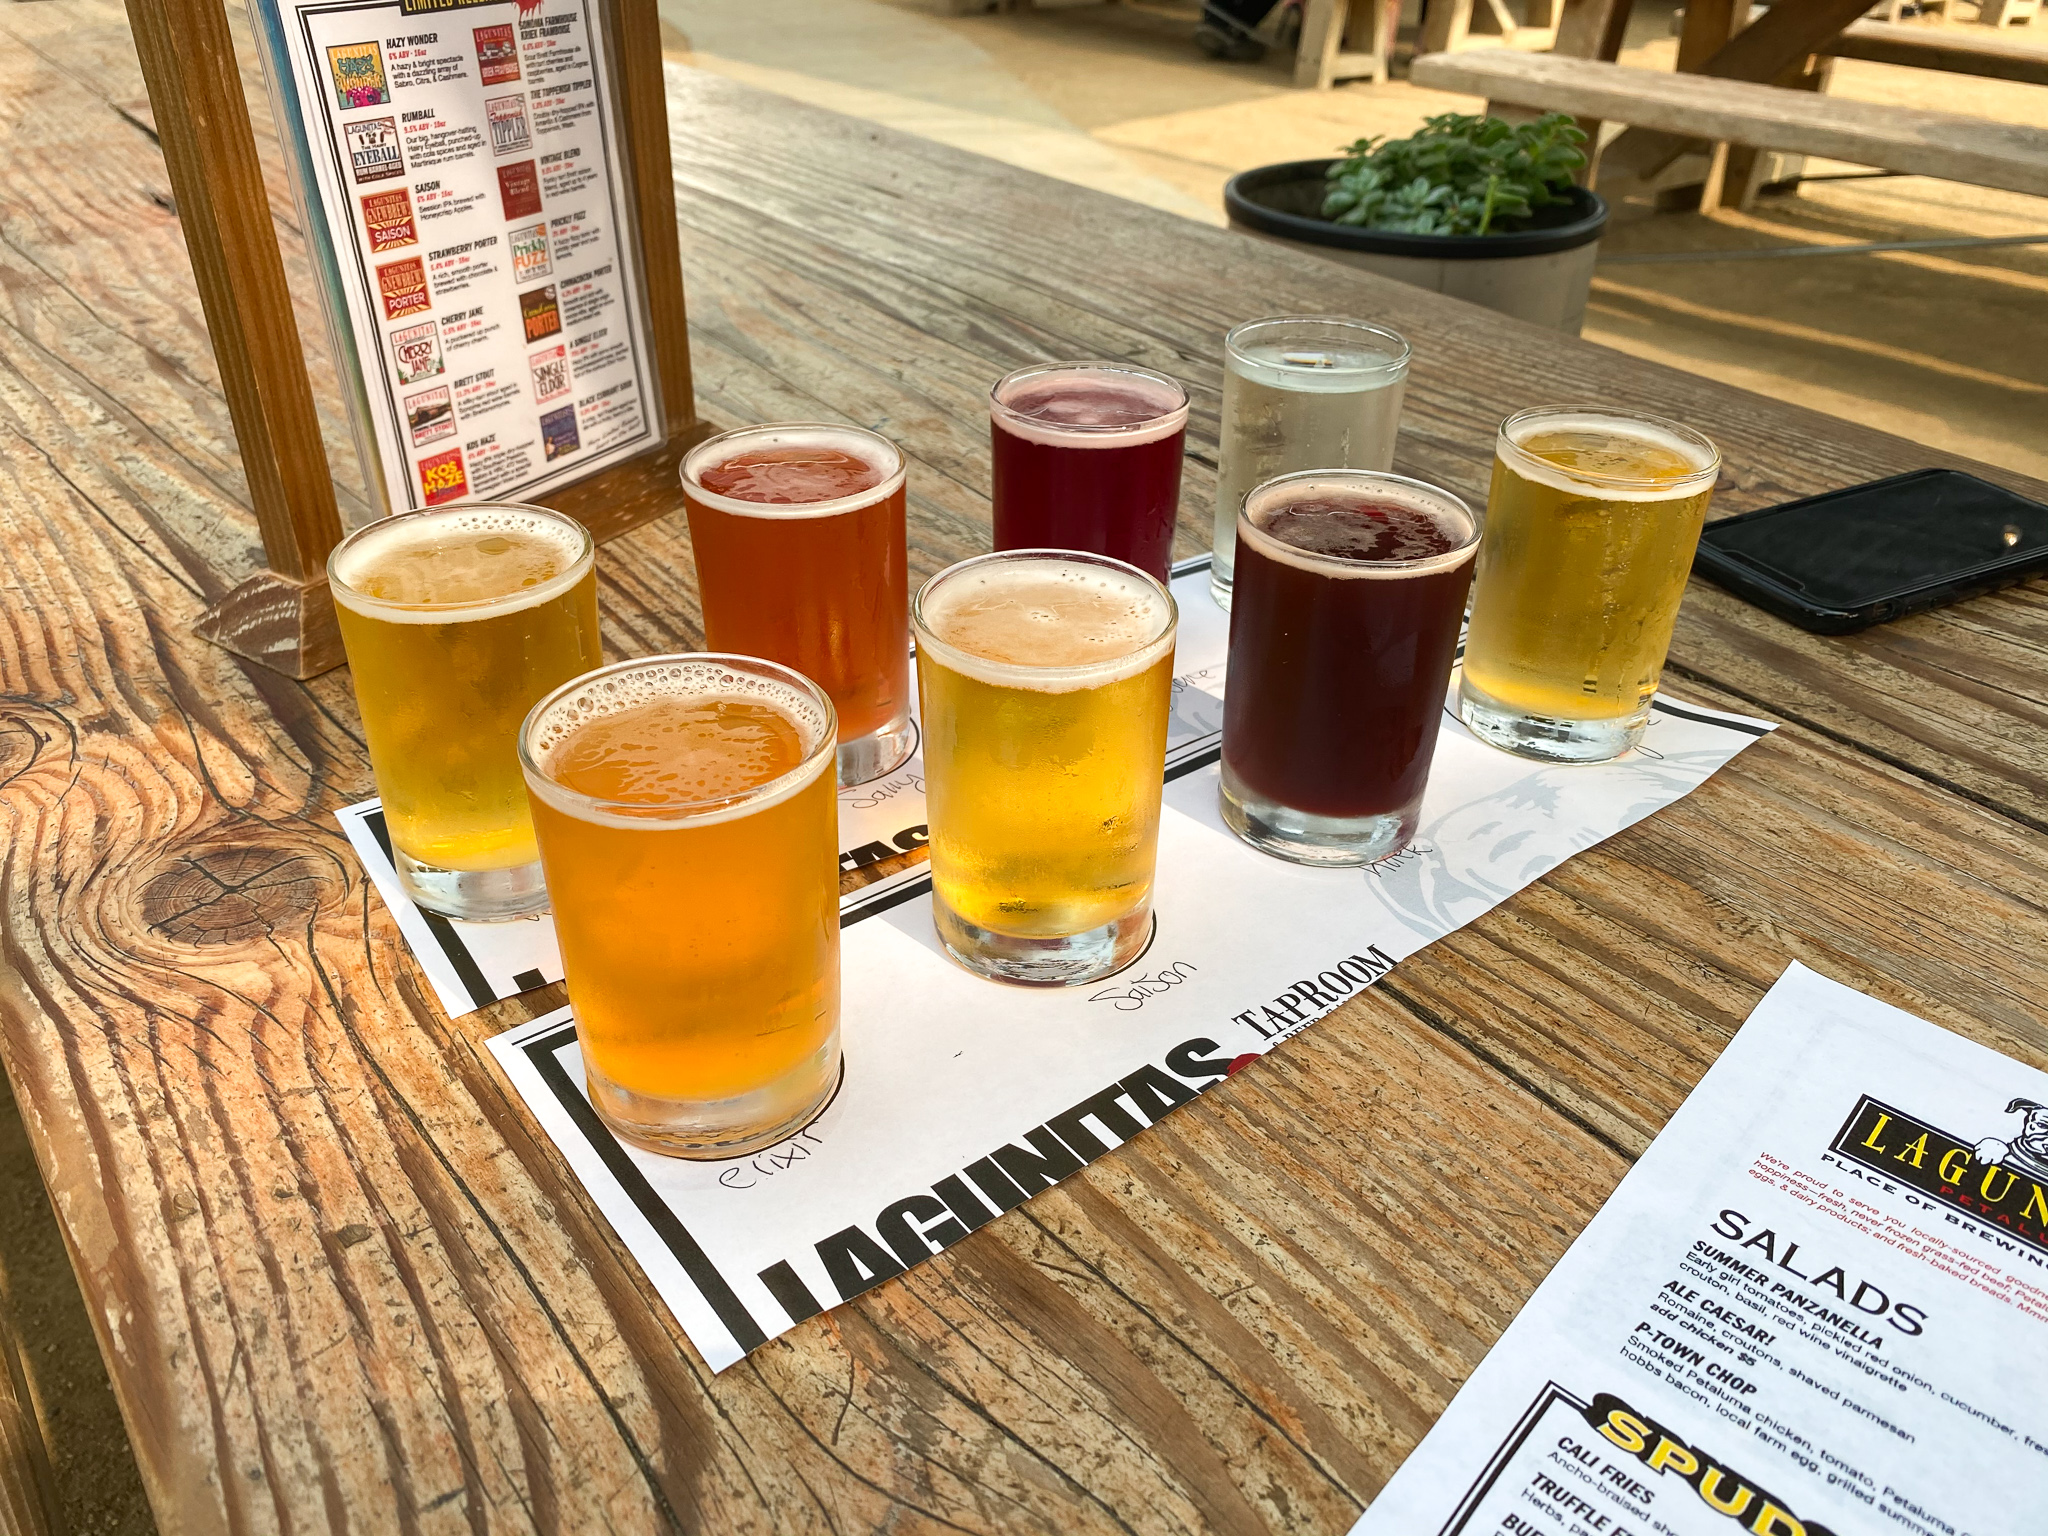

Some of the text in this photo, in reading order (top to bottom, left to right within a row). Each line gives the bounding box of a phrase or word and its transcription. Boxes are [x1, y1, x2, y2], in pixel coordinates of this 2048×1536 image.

[386, 33, 438, 49] HAZY WONDER
[399, 50, 409, 59] ABV
[418, 59, 435, 68] bright
[412, 67, 436, 79] dazzling
[437, 66, 451, 74] array
[402, 109, 435, 123] RUMBALL
[419, 123, 429, 131] ABV
[352, 146, 400, 166] EYEBALL
[436, 147, 455, 156] spices
[467, 141, 481, 150] aged
[415, 181, 440, 194] SAISON
[375, 226, 410, 242] SAISON
[429, 236, 497, 261] STRAWBERRY PORTER
[514, 249, 548, 269] FUZZ
[389, 292, 425, 310] PORTER
[441, 307, 483, 326] CHERRY JANE
[525, 311, 559, 338] PORTER
[475, 369, 494, 382] STOUT
[423, 471, 464, 495] HAZE
[426, 461, 459, 482] KOS
[1087, 961, 1198, 1011] Saison
[1233, 943, 1399, 1041] TAPROOM
[718, 1120, 823, 1189] elixir
[1748, 1168, 1774, 1184] eggs,
[1789, 1190, 1816, 1205] dairy
[1872, 1232, 1896, 1245] and
[1896, 1243, 1968, 1280] fresh-baked
[1760, 1152, 2001, 1274] We're proud to serve you locally-sourced
[1820, 1153, 2048, 1274] PLACE OF BREWIN
[1853, 1210, 1881, 1226] never
[1885, 1225, 1920, 1245] frozen
[1921, 1245, 1979, 1275] grass-fed
[1692, 1240, 1883, 1349] SUMMER PANZANELLA
[1709, 1209, 1928, 1336] SALADS
[1649, 1303, 1756, 1366] add chicken $5
[1662, 1280, 1776, 1345] ALE CAESAR!
[1679, 1262, 1907, 1391] crouton, basil, red wine vinaigrette
[1634, 1321, 1757, 1394] P-TOWN CHOP
[1657, 1291, 1915, 1443] Romaine, croutons, shaved parmesan
[1685, 1250, 1717, 1273] Early
[1718, 1271, 1741, 1286] girl
[1743, 1282, 1806, 1324] tomatoes,
[1810, 1322, 1862, 1352] pickled
[1864, 1351, 1889, 1367] red
[1891, 1366, 1934, 1394] onion,
[1940, 1392, 2017, 1440] cucumber,
[1619, 1345, 1874, 1505] hobbs bacon, local farm egg, grilled
[1627, 1335, 1956, 1536] Smoked Petaluma chicken, tomato, Petaluma
[1547, 1451, 1650, 1522] Ancho-braised
[1557, 1436, 1655, 1504] CALI FRIES
[1520, 1487, 1564, 1525] Herbs,
[1531, 1471, 1611, 1531] TRUFFLE
